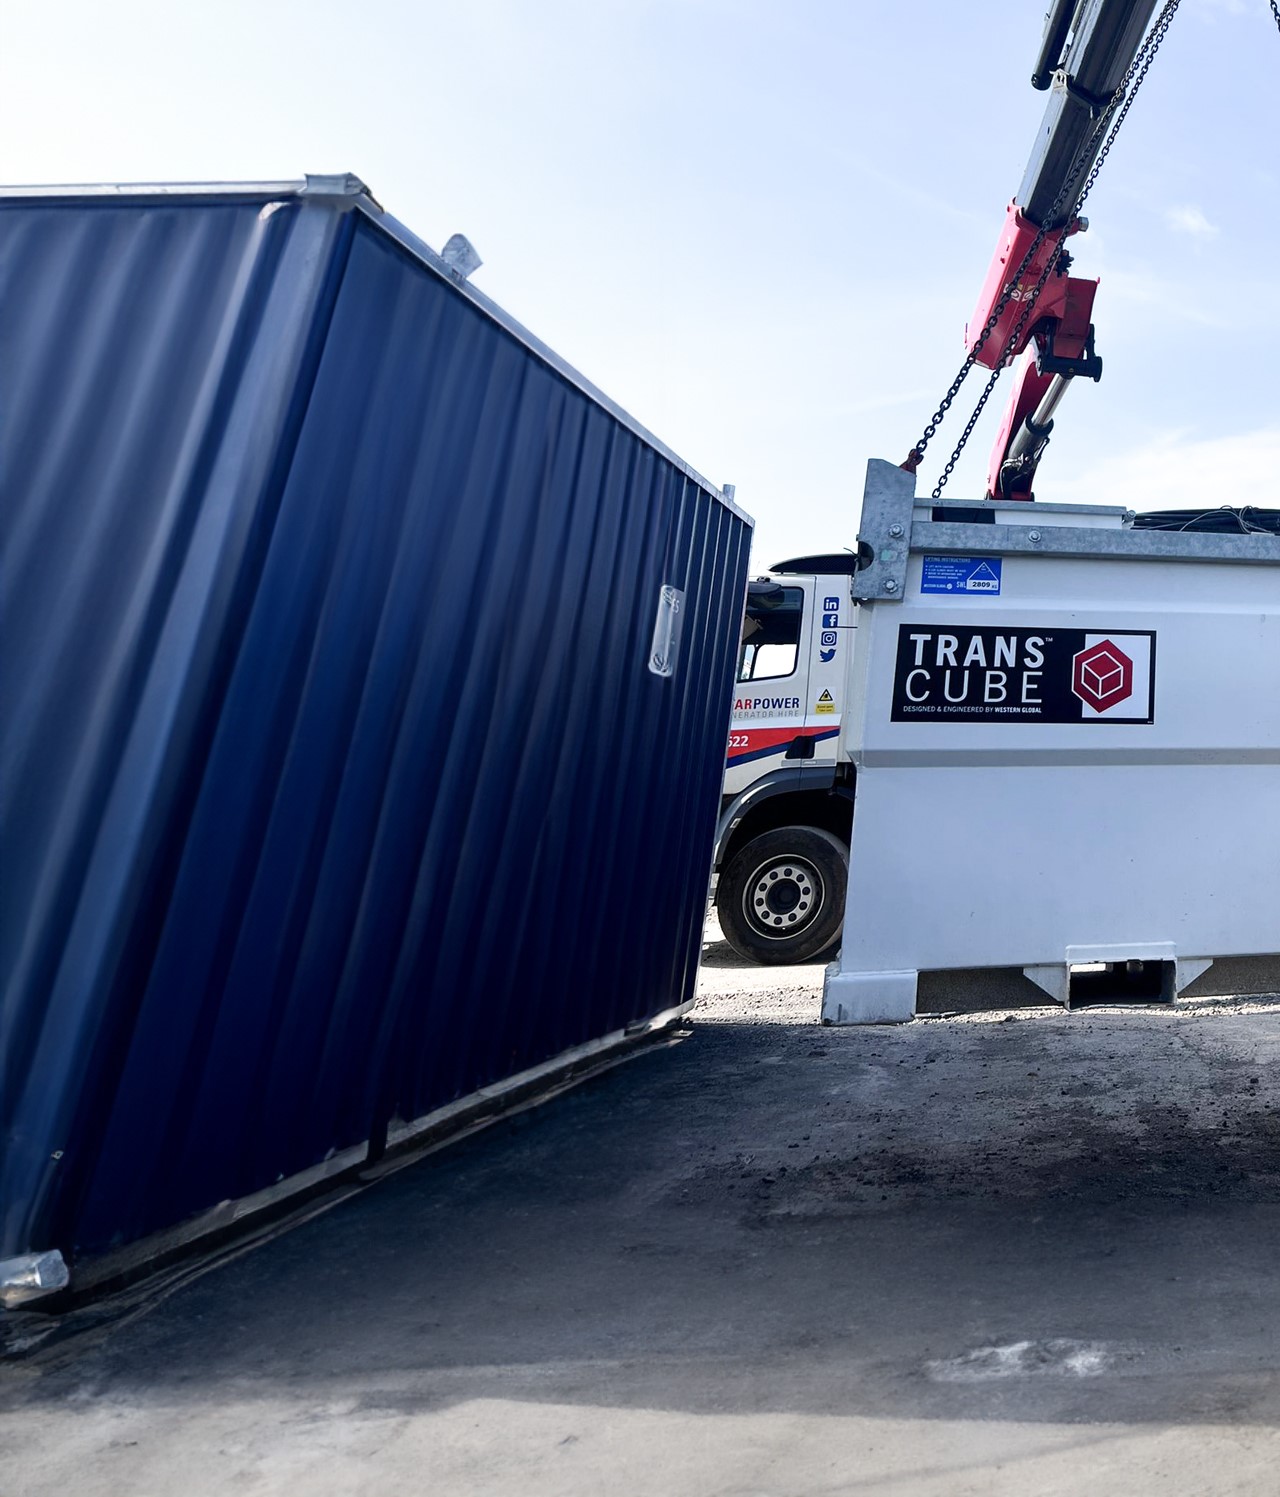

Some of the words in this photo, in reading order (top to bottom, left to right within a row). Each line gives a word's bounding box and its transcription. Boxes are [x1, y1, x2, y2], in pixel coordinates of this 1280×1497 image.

[905, 668, 1043, 704] CUBE
[732, 697, 800, 710] ARPOWER
[903, 705, 936, 713] DESIGNED
[943, 705, 984, 713] ENGINEERED
[777, 709, 799, 718] HIRE
